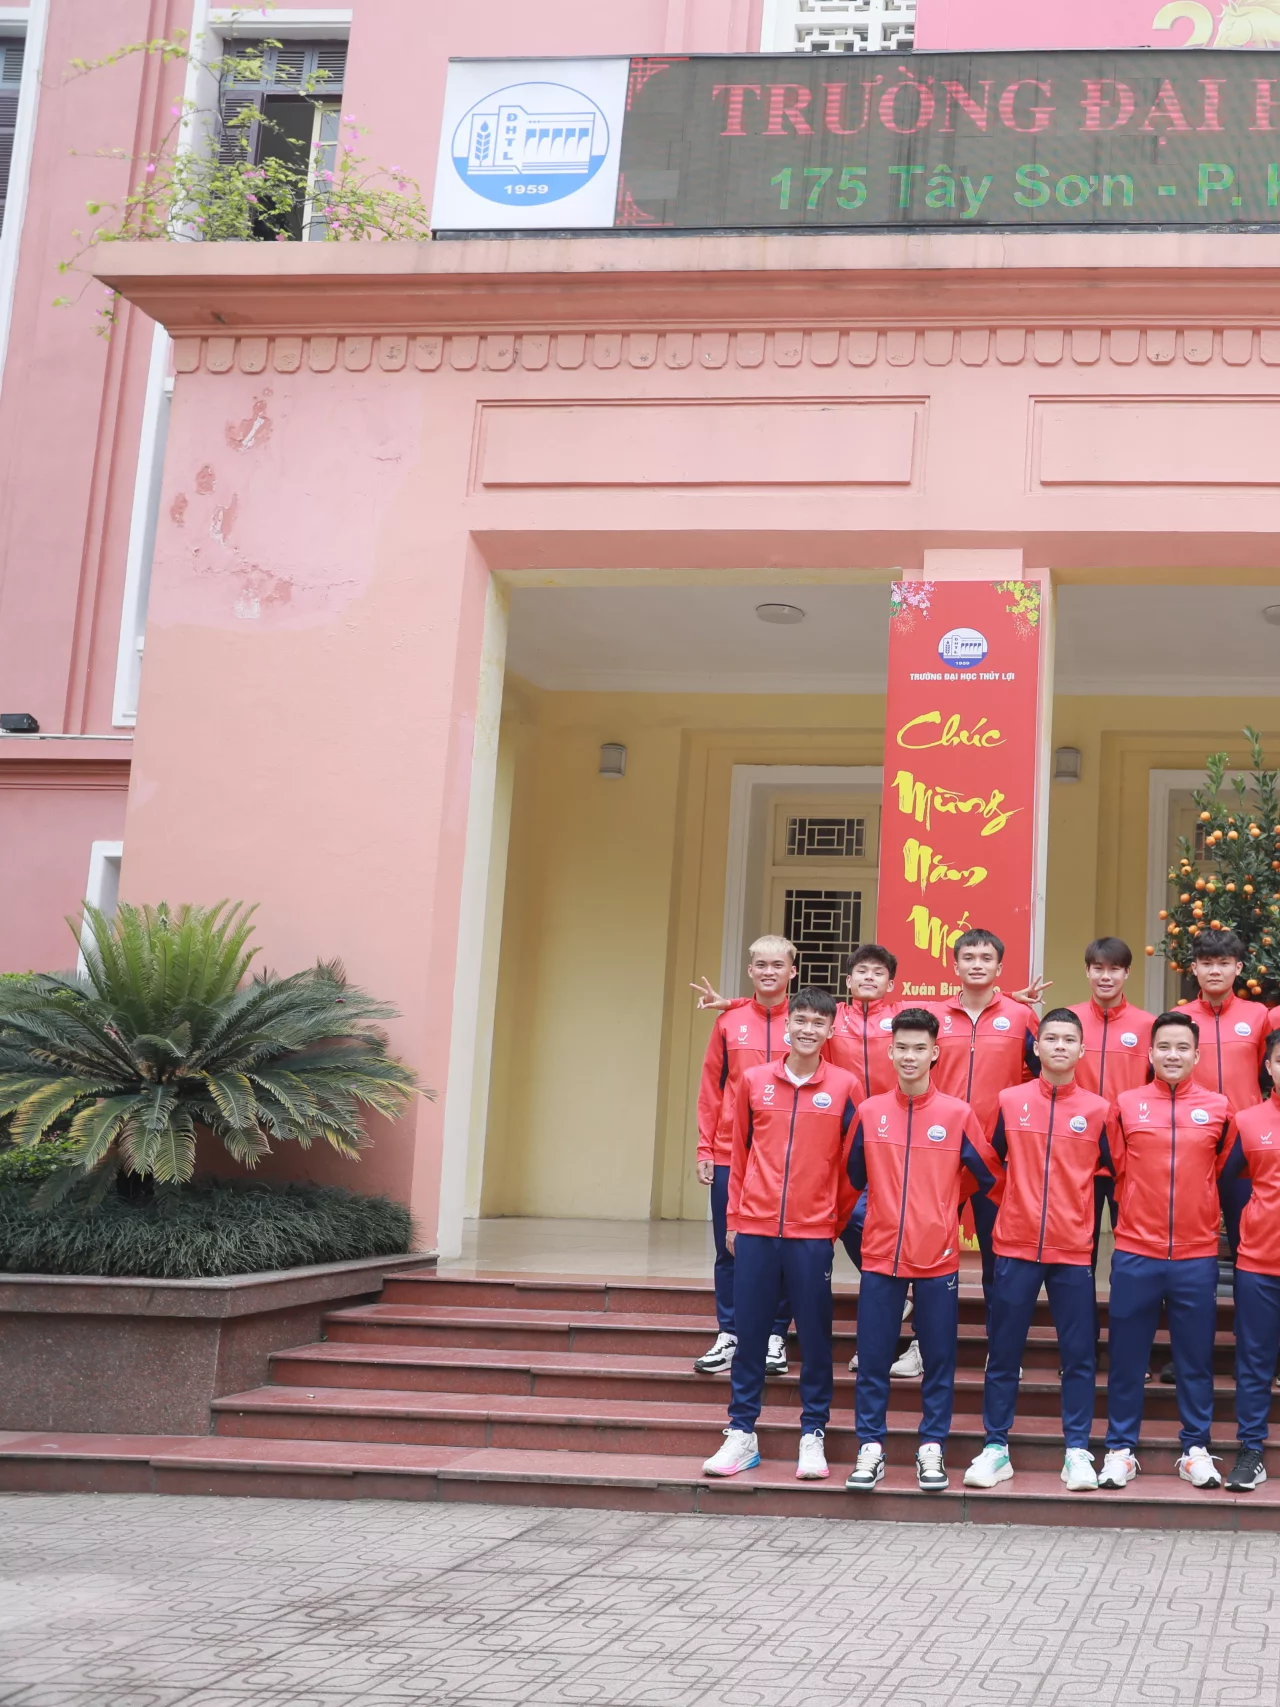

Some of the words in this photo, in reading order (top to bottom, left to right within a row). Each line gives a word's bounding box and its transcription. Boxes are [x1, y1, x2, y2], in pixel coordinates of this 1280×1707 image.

[712, 65, 1057, 137] TRƯỜNG
[1079, 78, 1226, 146] ĐẠI
[503, 184, 549, 195] 1959
[770, 165, 868, 211] 175
[886, 164, 994, 219] Tây
[1013, 163, 1135, 209] Sơn
[1157, 184, 1177, 196] -
[1198, 163, 1242, 208] P.
[909, 671, 943, 681] TRƯỜNG
[944, 673, 958, 682] ĐẠI
[960, 672, 977, 682] HỌC
[979, 671, 1000, 681] THỦY
[1002, 672, 1015, 682] LỢI
[896, 710, 1008, 750] Chúc
[891, 770, 1024, 836] Mừng
[903, 838, 988, 896] Năm
[901, 981, 936, 996] Xuân
[940, 981, 963, 996] Bín
[740, 1025, 747, 1033] 16
[764, 1084, 775, 1094] 22
[1023, 1103, 1028, 1112] 4
[1139, 1103, 1148, 1112] 14
[880, 1115, 886, 1124] 8
